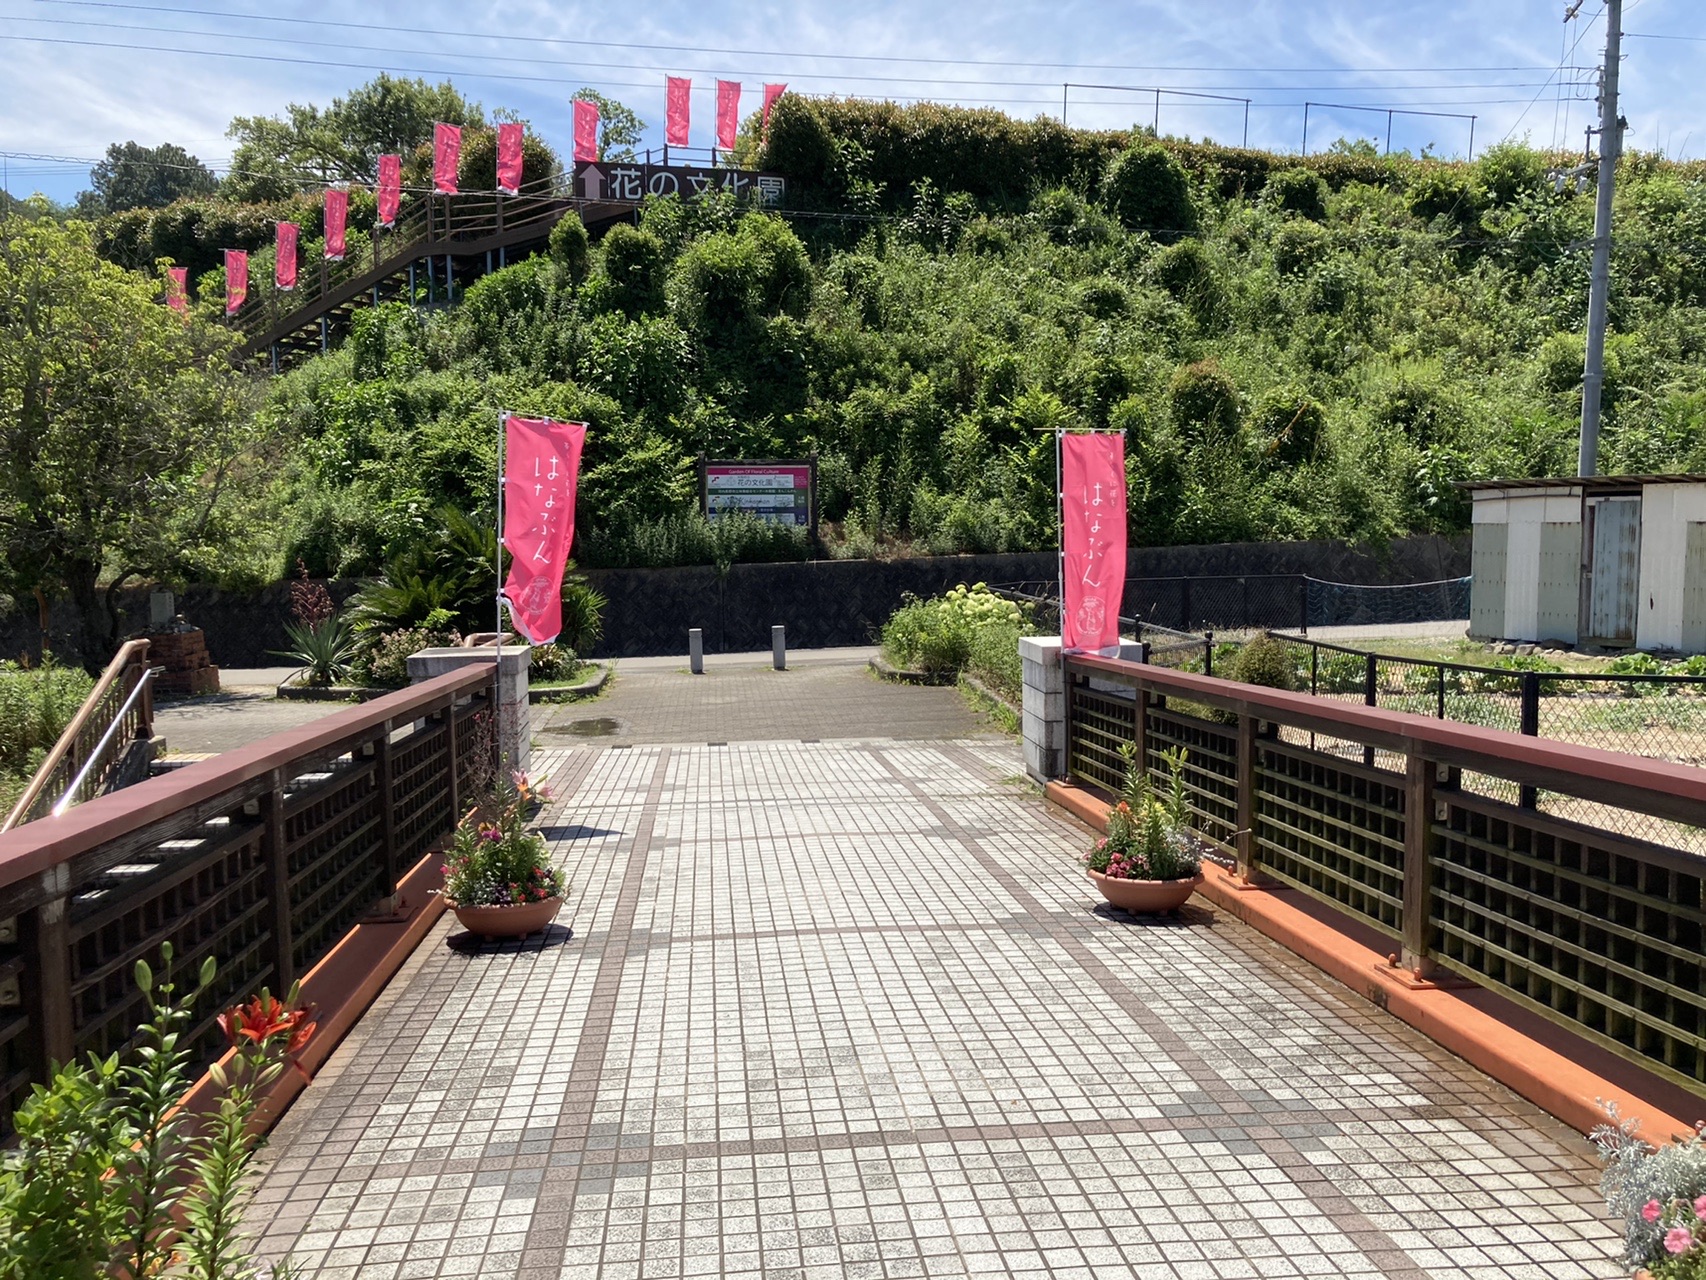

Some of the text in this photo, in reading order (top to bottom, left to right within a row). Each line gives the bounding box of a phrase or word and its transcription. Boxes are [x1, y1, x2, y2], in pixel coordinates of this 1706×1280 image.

[610, 167, 785, 206] 花の文化園
[532, 455, 559, 564] はなぶん
[1081, 482, 1103, 588] はなぶん
